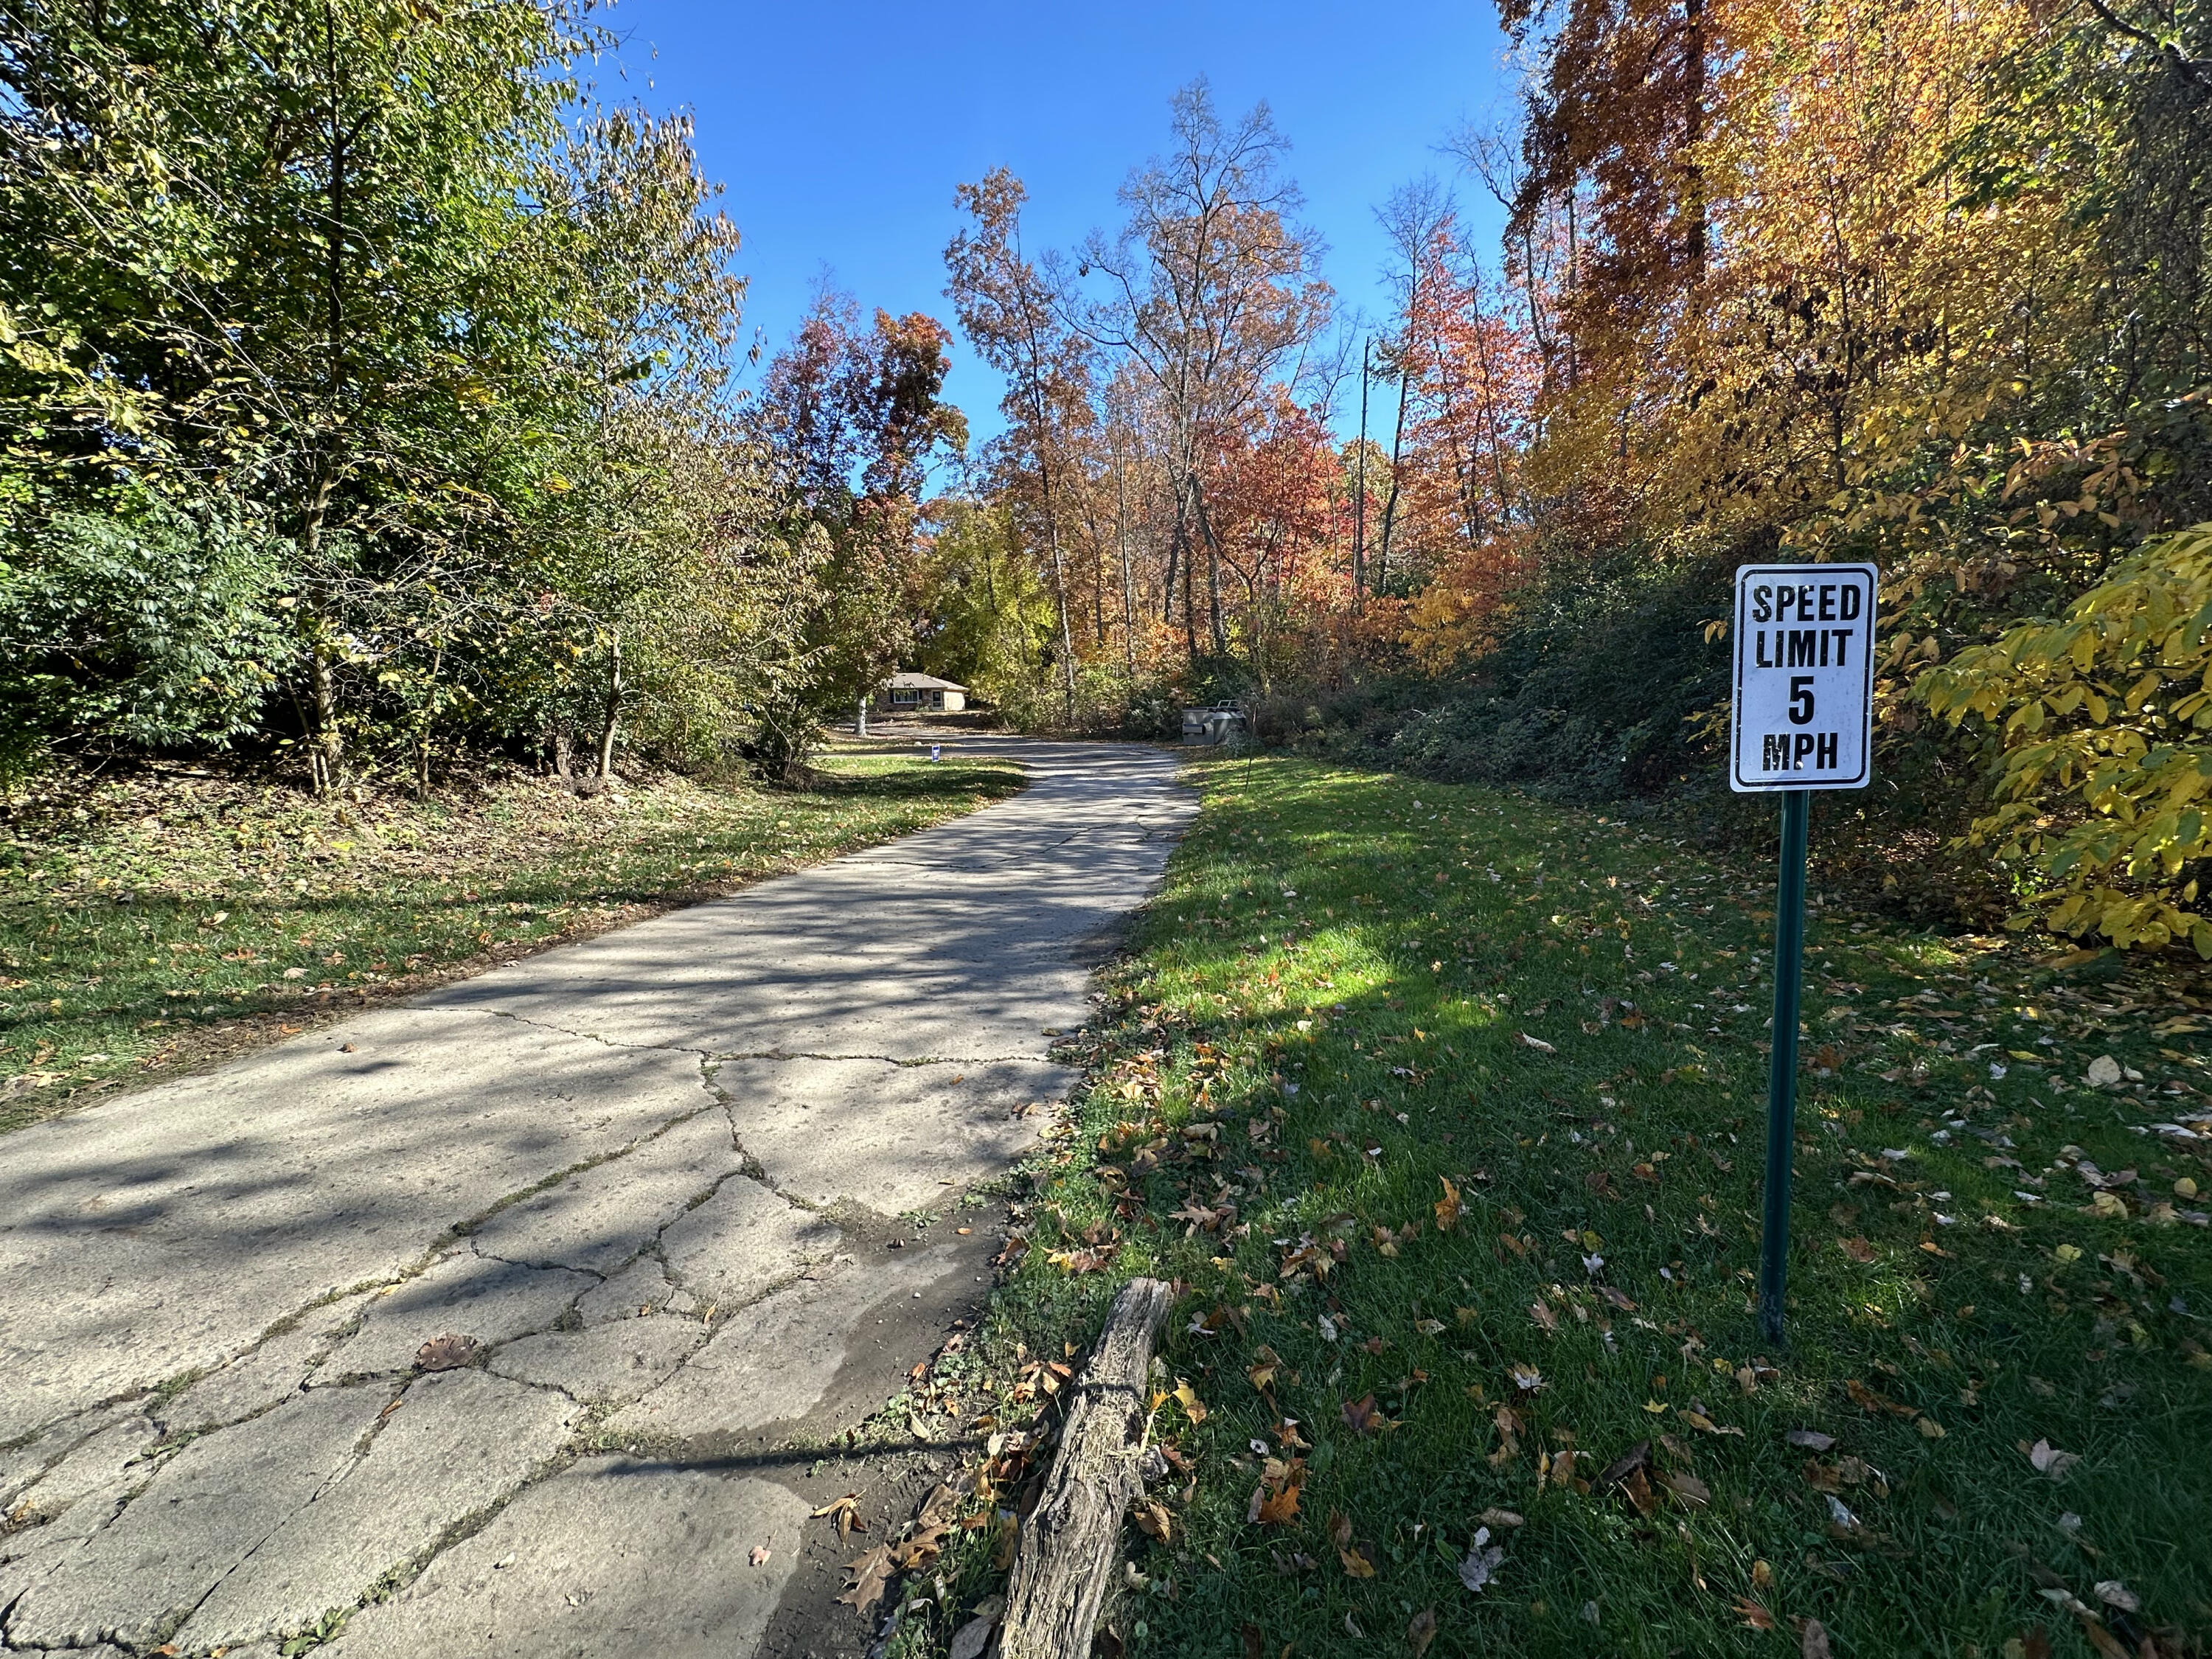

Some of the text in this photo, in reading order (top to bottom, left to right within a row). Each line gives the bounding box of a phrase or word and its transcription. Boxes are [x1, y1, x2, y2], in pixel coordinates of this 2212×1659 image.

[1753, 585, 1860, 622] SPEED
[1756, 629, 1853, 668] LIMIT
[1789, 676, 1815, 725] 5
[1762, 733, 1837, 771] MPH
